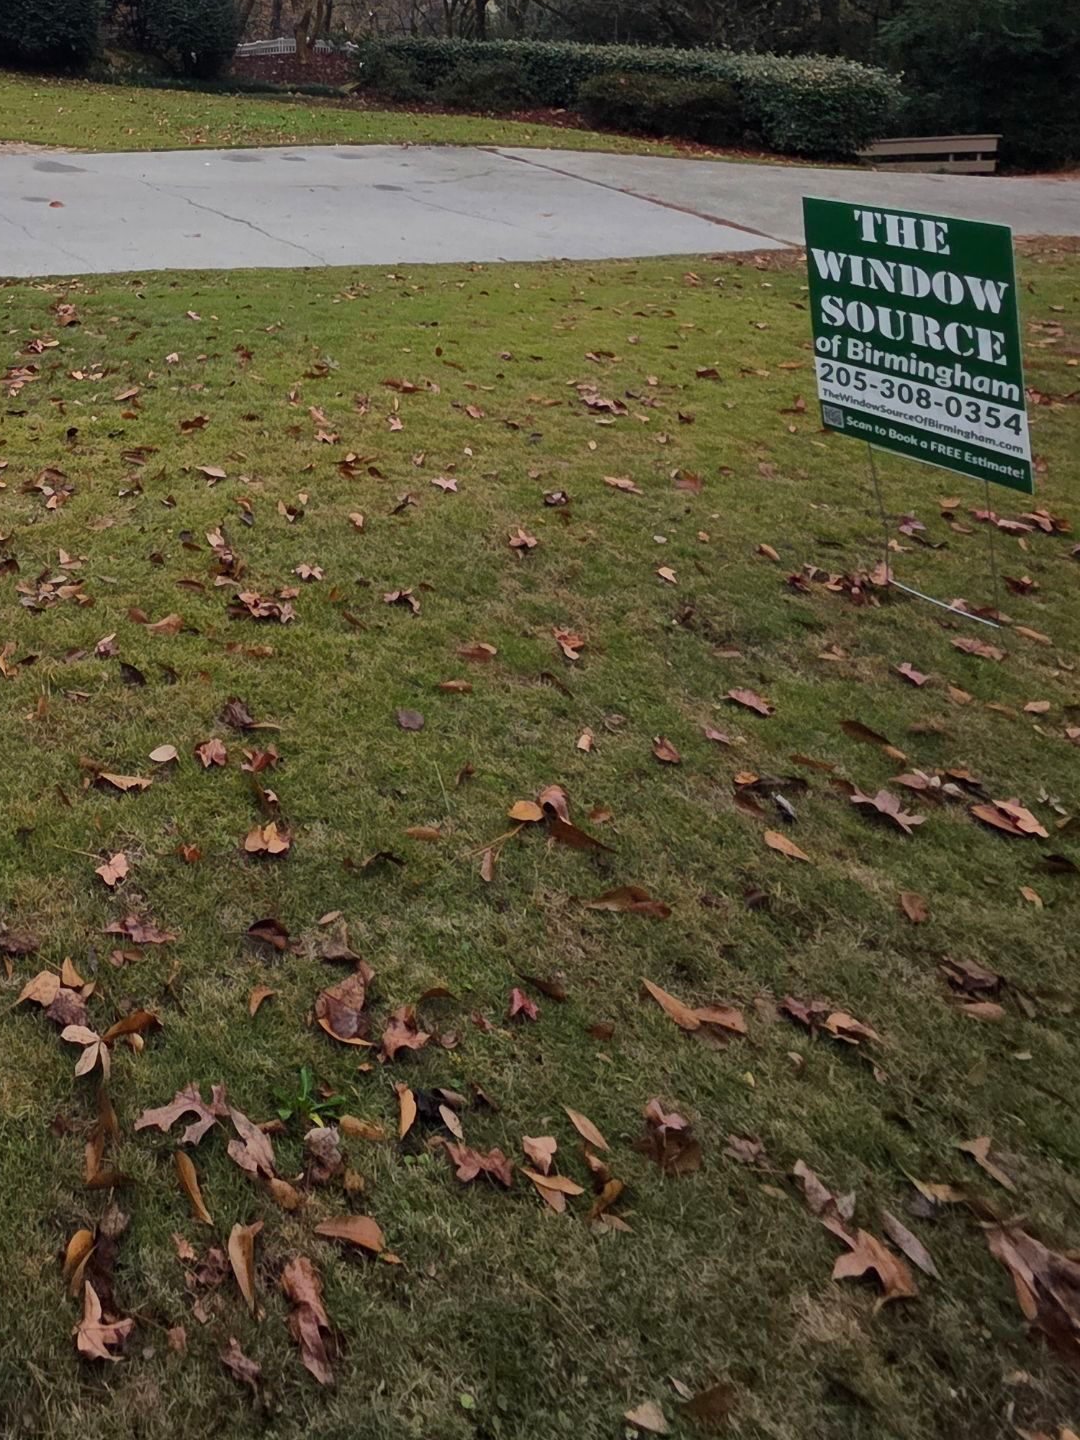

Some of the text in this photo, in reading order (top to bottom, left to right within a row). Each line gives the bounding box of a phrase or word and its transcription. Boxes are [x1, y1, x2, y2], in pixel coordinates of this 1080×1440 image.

[854, 209, 950, 255] THE
[811, 248, 1009, 314] WINDOW
[820, 295, 1007, 366] SOURCE
[816, 334, 1020, 402] of Birmingham
[820, 363, 1022, 436] 205-308-0354
[822, 389, 1024, 454] TheWindowSourceOfBirmingham.com
[846, 416, 1024, 480] Scan to Book a FREE Estimate!
